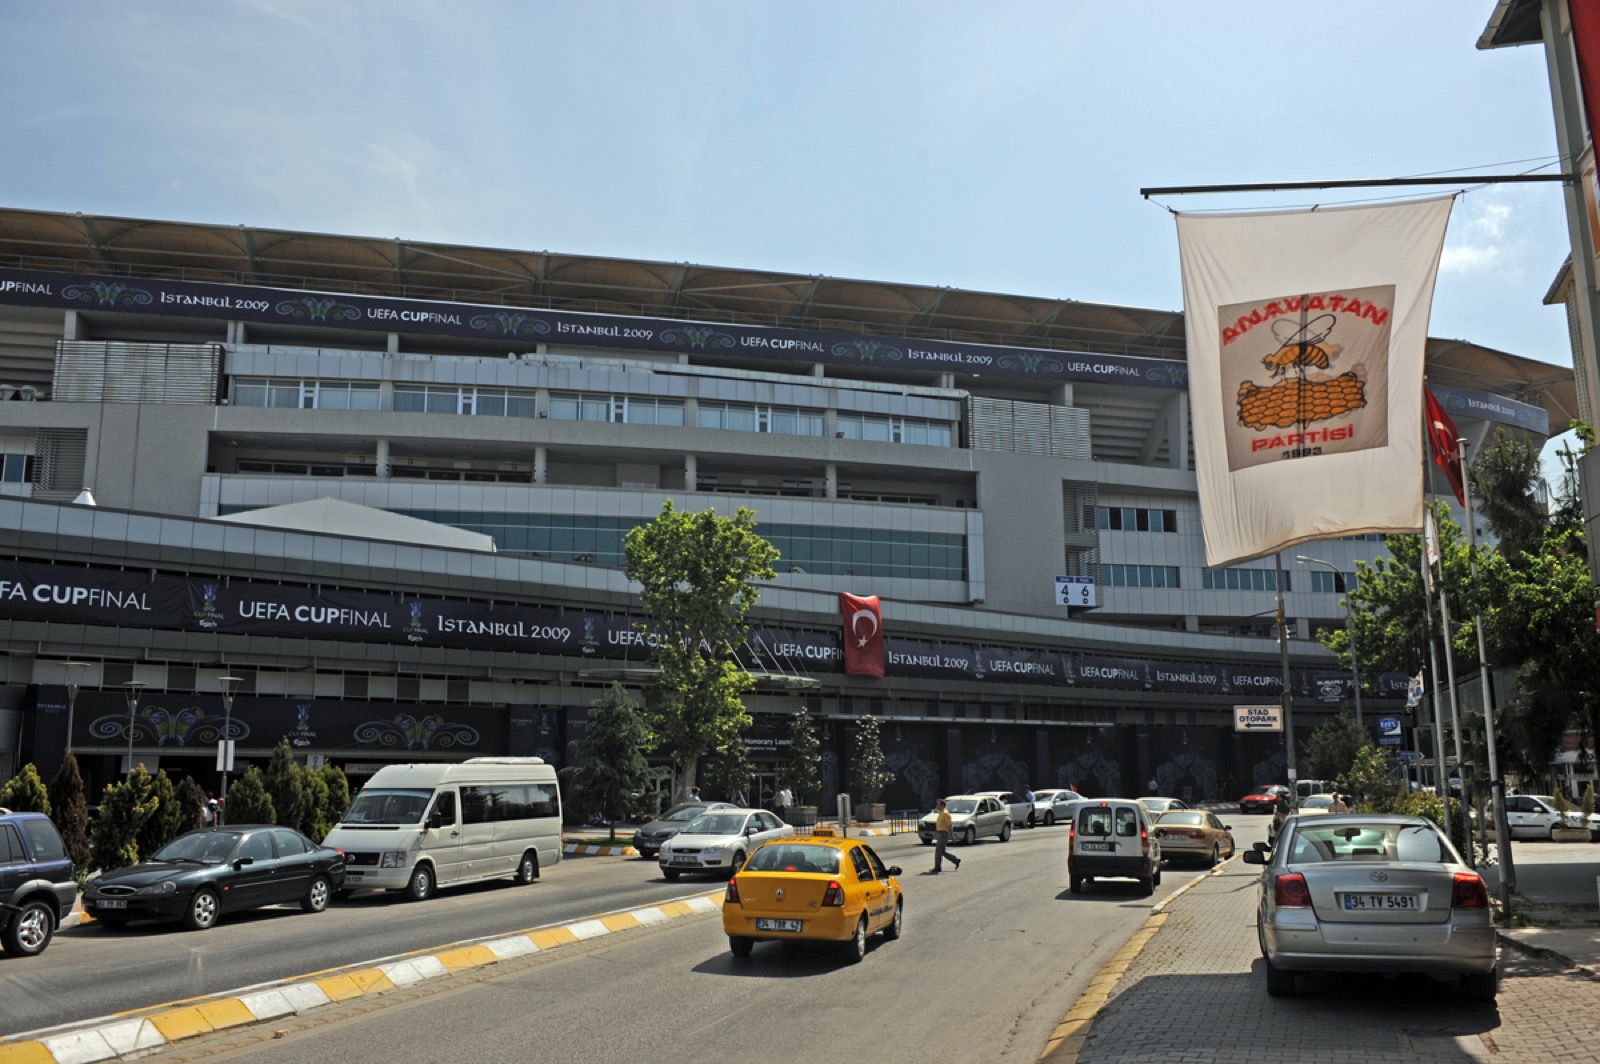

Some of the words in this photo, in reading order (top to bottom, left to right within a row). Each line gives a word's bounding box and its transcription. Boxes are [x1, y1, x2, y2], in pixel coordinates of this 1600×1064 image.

[235, 300, 269, 312] 2009
[367, 308, 399, 320] UEFA
[1222, 295, 1391, 348] ANAVATAN
[623, 328, 654, 341] 2009
[740, 336, 769, 348] UEFA
[966, 354, 993, 366] 2009
[1067, 362, 1092, 373] UEFA
[1281, 446, 1322, 461] 1983
[1061, 584, 1069, 596] 4
[1082, 585, 1089, 597] 6
[239, 600, 291, 621] UEFA
[531, 624, 571, 643] 2009
[608, 630, 646, 646] UEFA
[773, 643, 804, 659] UEFA
[944, 657, 969, 671] 2009
[990, 660, 1013, 673] UEFA
[1080, 666, 1101, 678] UEFA
[1198, 674, 1217, 686] 2009
[1232, 675, 1252, 686] UEFA
[1247, 708, 1270, 716] STAD
[1239, 715, 1278, 723] OTOPARK
[1352, 896, 1366, 908] 34
[1387, 896, 1414, 908] 5491
